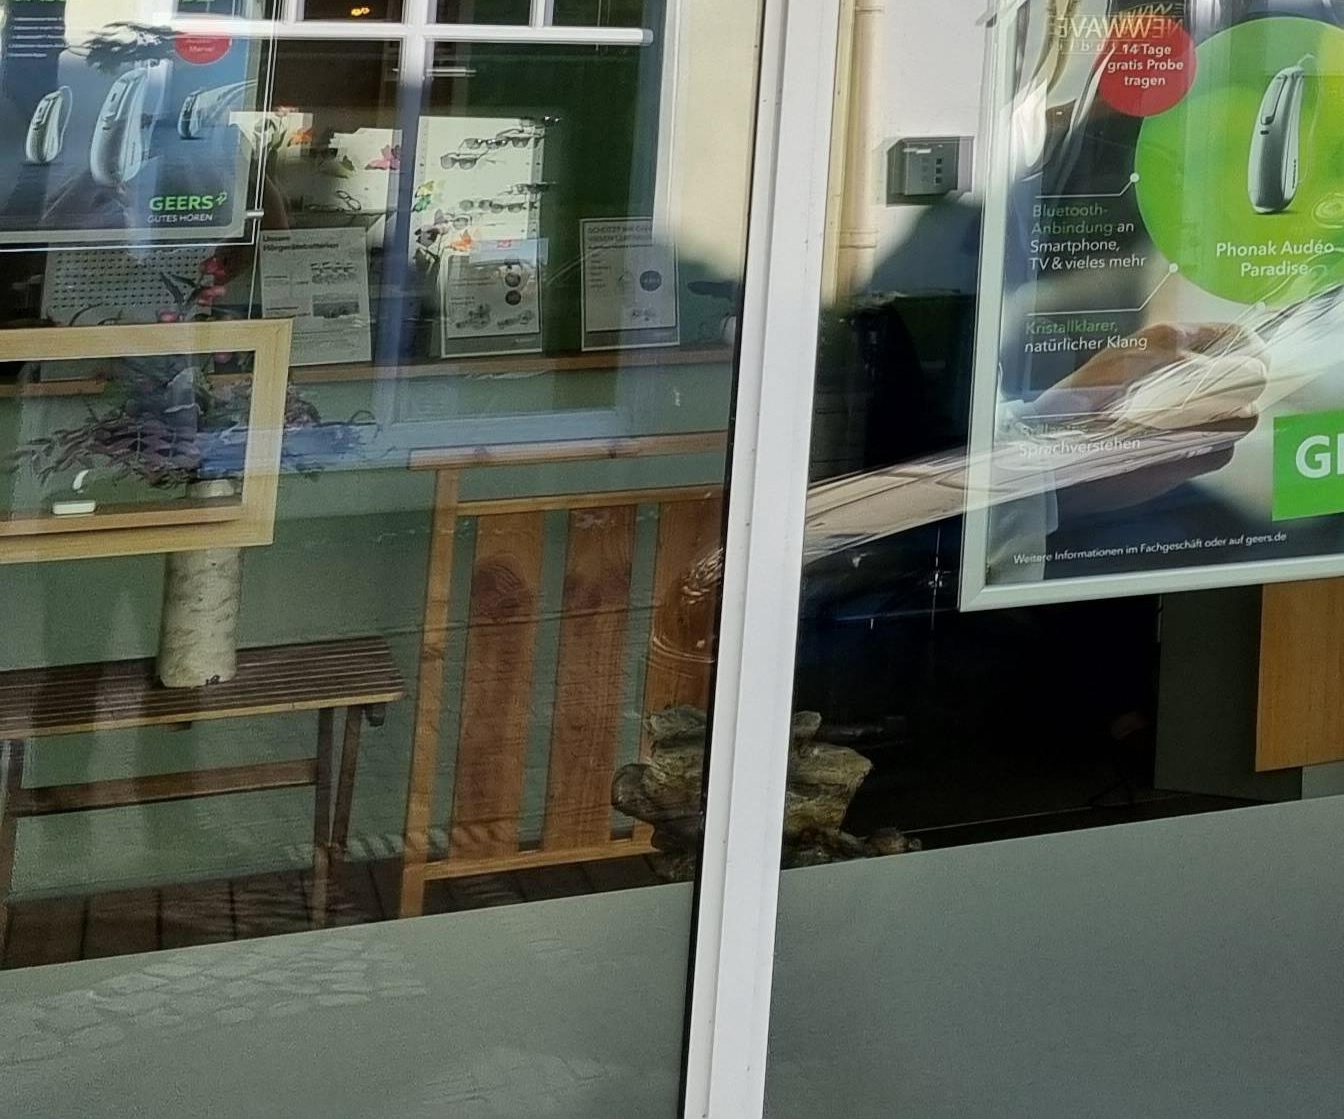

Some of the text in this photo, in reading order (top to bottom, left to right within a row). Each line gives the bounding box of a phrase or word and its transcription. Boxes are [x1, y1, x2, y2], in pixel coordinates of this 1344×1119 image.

[1142, 43, 1172, 57] Tage
[1107, 59, 1184, 73] gratis Probe
[1124, 76, 1166, 89] tragen
[149, 195, 214, 212] GEERS
[1032, 203, 1108, 218] Bluetooth-
[147, 214, 177, 223] GUTES
[1031, 222, 1134, 237] Anbindung an
[1030, 240, 1121, 255] Smartphone,
[1215, 239, 1335, 259] Phonak Audéo
[1029, 255, 1146, 271] TV & vieles mehr
[1240, 262, 1310, 278] Paradise
[1025, 320, 1118, 335] Kristallklarer,
[1024, 336, 1148, 353] natürlicher Klang
[1014, 532, 1287, 565] Weitere Informationen im Fachgeschäft oder auf geers.de
